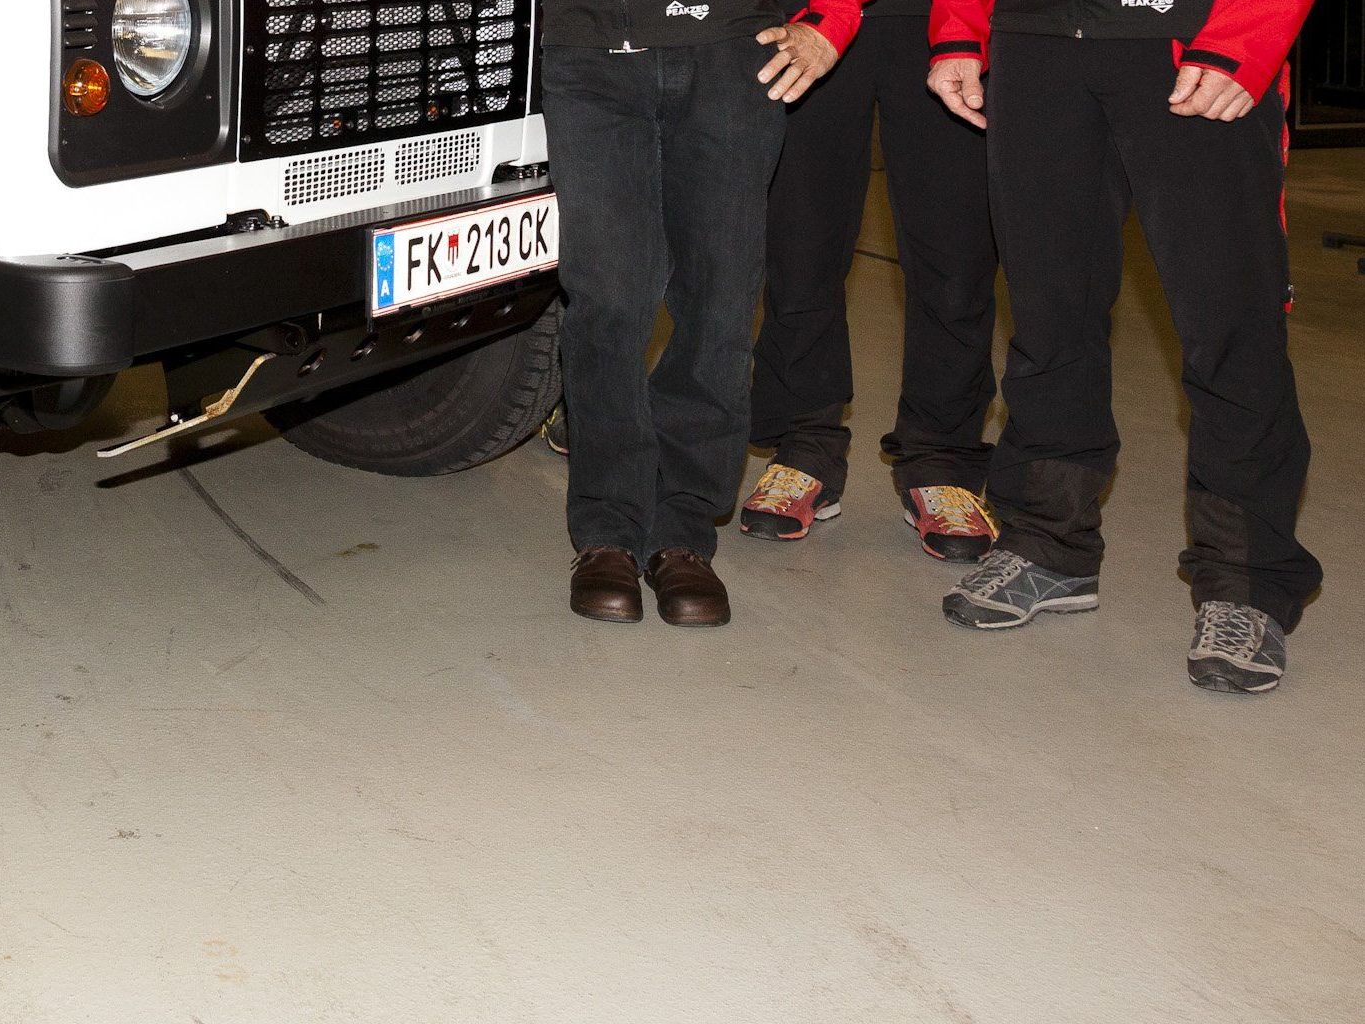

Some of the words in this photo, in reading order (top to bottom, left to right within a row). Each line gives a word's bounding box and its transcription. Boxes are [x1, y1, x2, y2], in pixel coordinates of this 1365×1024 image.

[407, 231, 443, 291] FK
[466, 216, 511, 275] 213
[519, 206, 549, 261] CK
[380, 279, 391, 297] A
